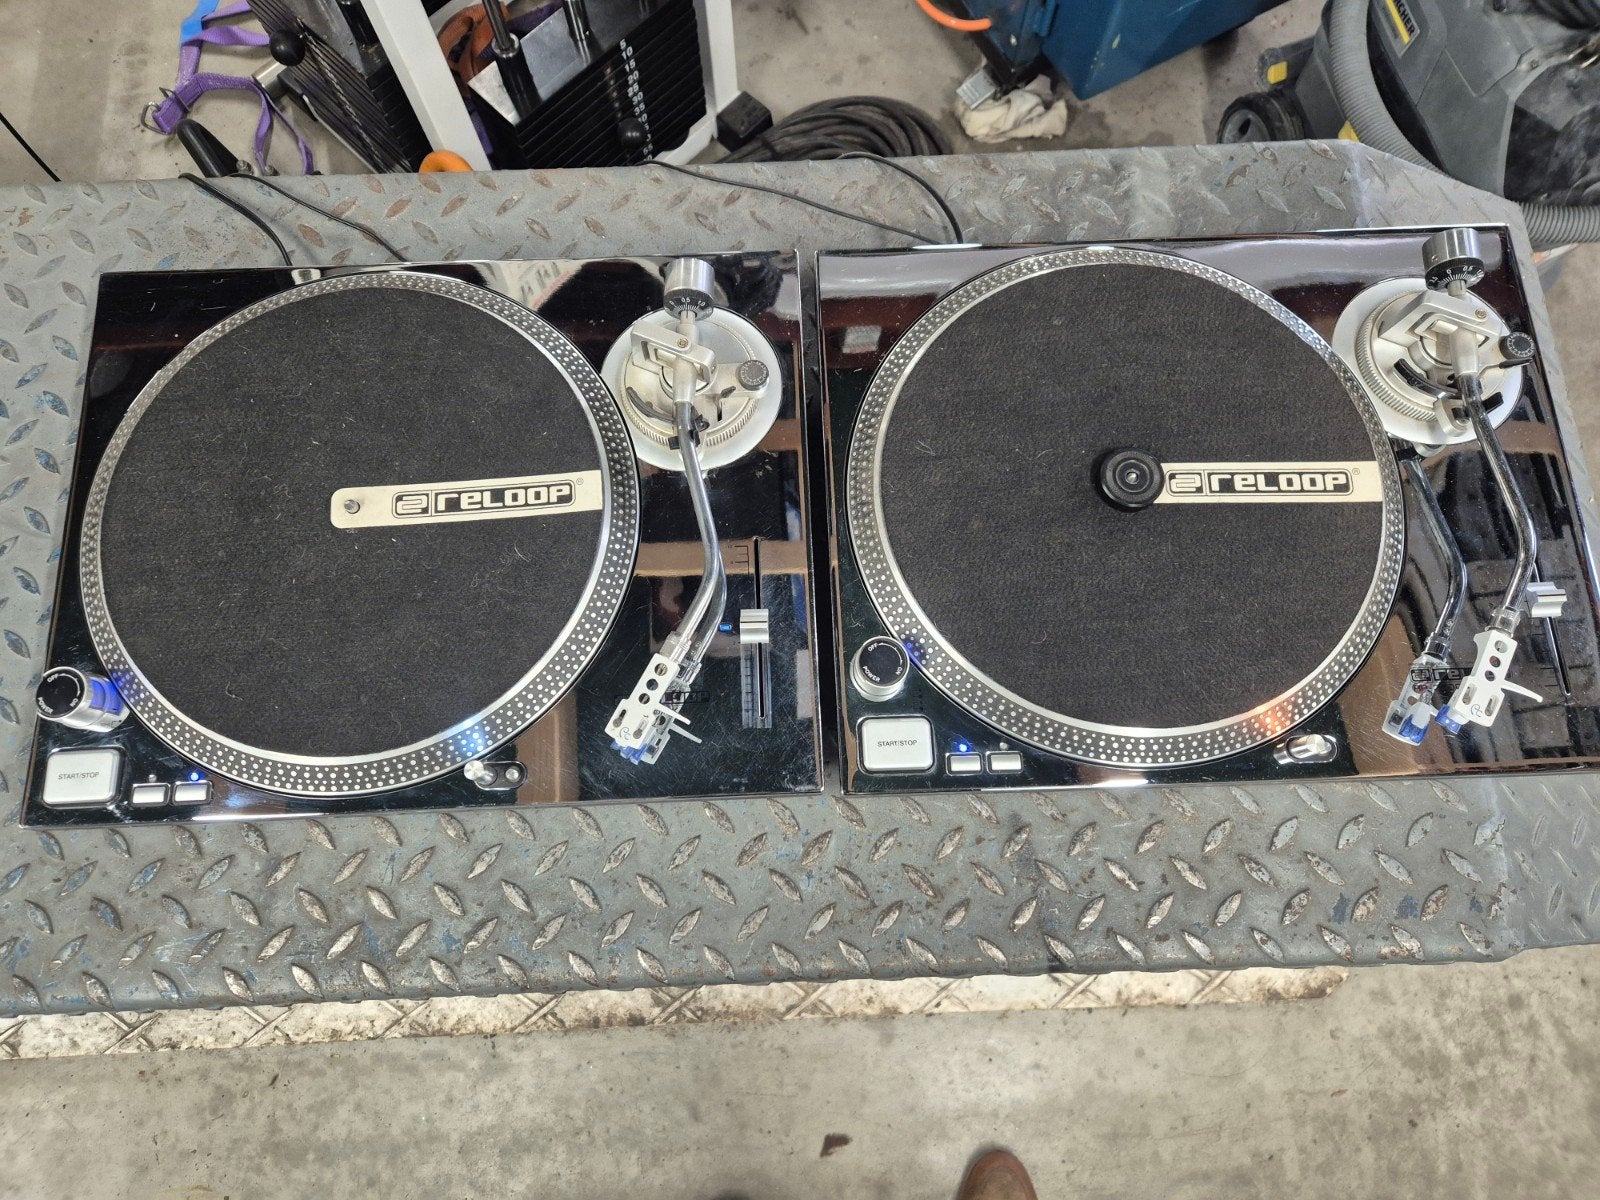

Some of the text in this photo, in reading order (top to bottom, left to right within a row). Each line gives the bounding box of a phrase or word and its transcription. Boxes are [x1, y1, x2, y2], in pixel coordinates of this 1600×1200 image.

[620, 38, 627, 50] 5
[621, 46, 633, 60] 10
[624, 58, 636, 72] 15
[627, 70, 639, 85] 20
[867, 642, 878, 652] OFF
[862, 665, 881, 683] POWER
[895, 666, 903, 676] ON
[47, 673, 59, 683] OFF
[37, 696, 54, 715] POWER
[69, 697, 79, 708] ON
[58, 771, 100, 780] START/STOP
